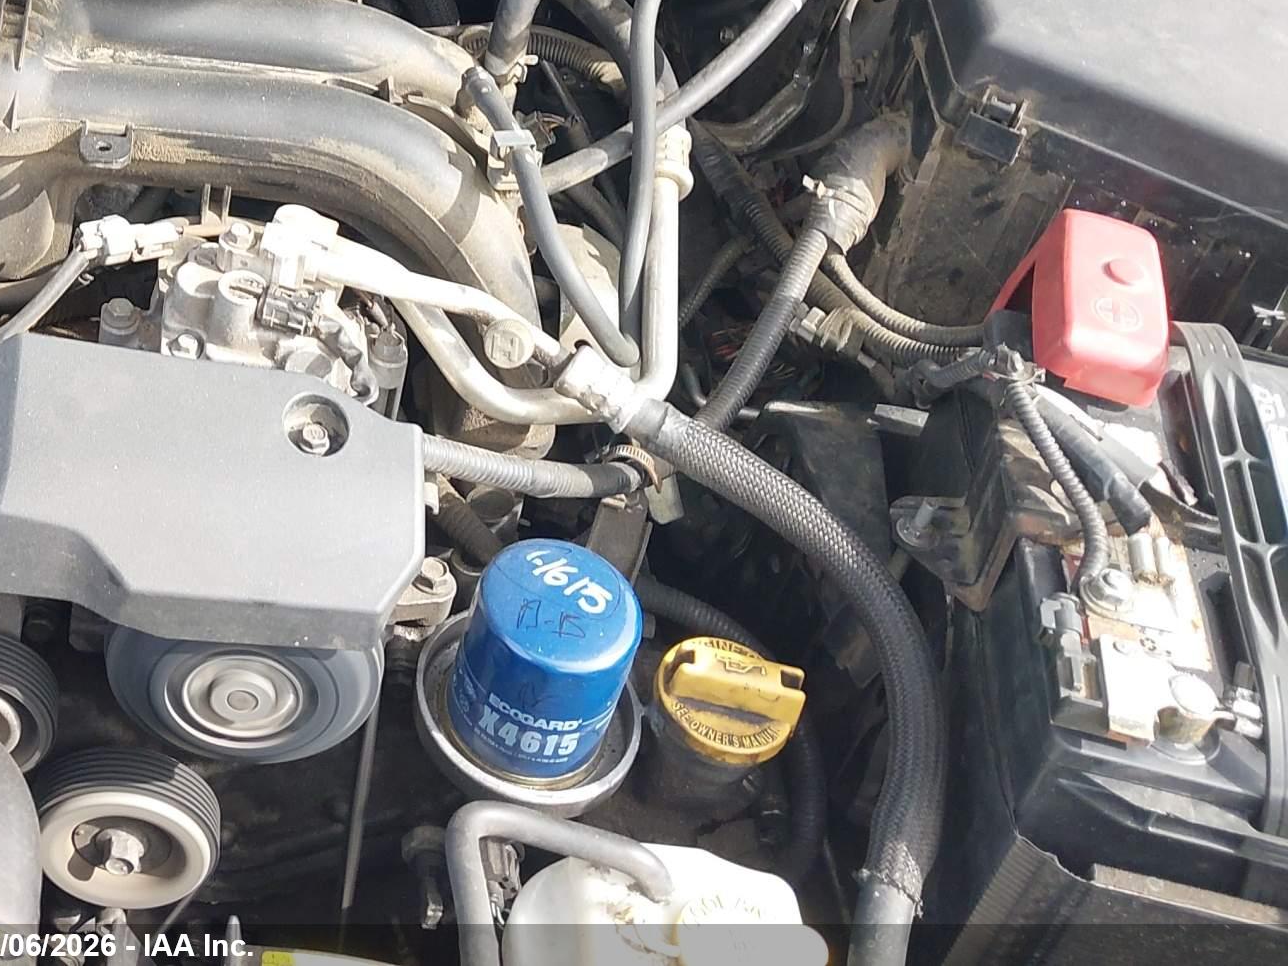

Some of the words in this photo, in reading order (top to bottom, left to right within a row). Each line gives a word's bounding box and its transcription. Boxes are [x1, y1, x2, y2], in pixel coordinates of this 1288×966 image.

[488, 691, 581, 732] ECOGARD
[672, 701, 692, 725] SEE
[690, 720, 741, 749] OWNER'S
